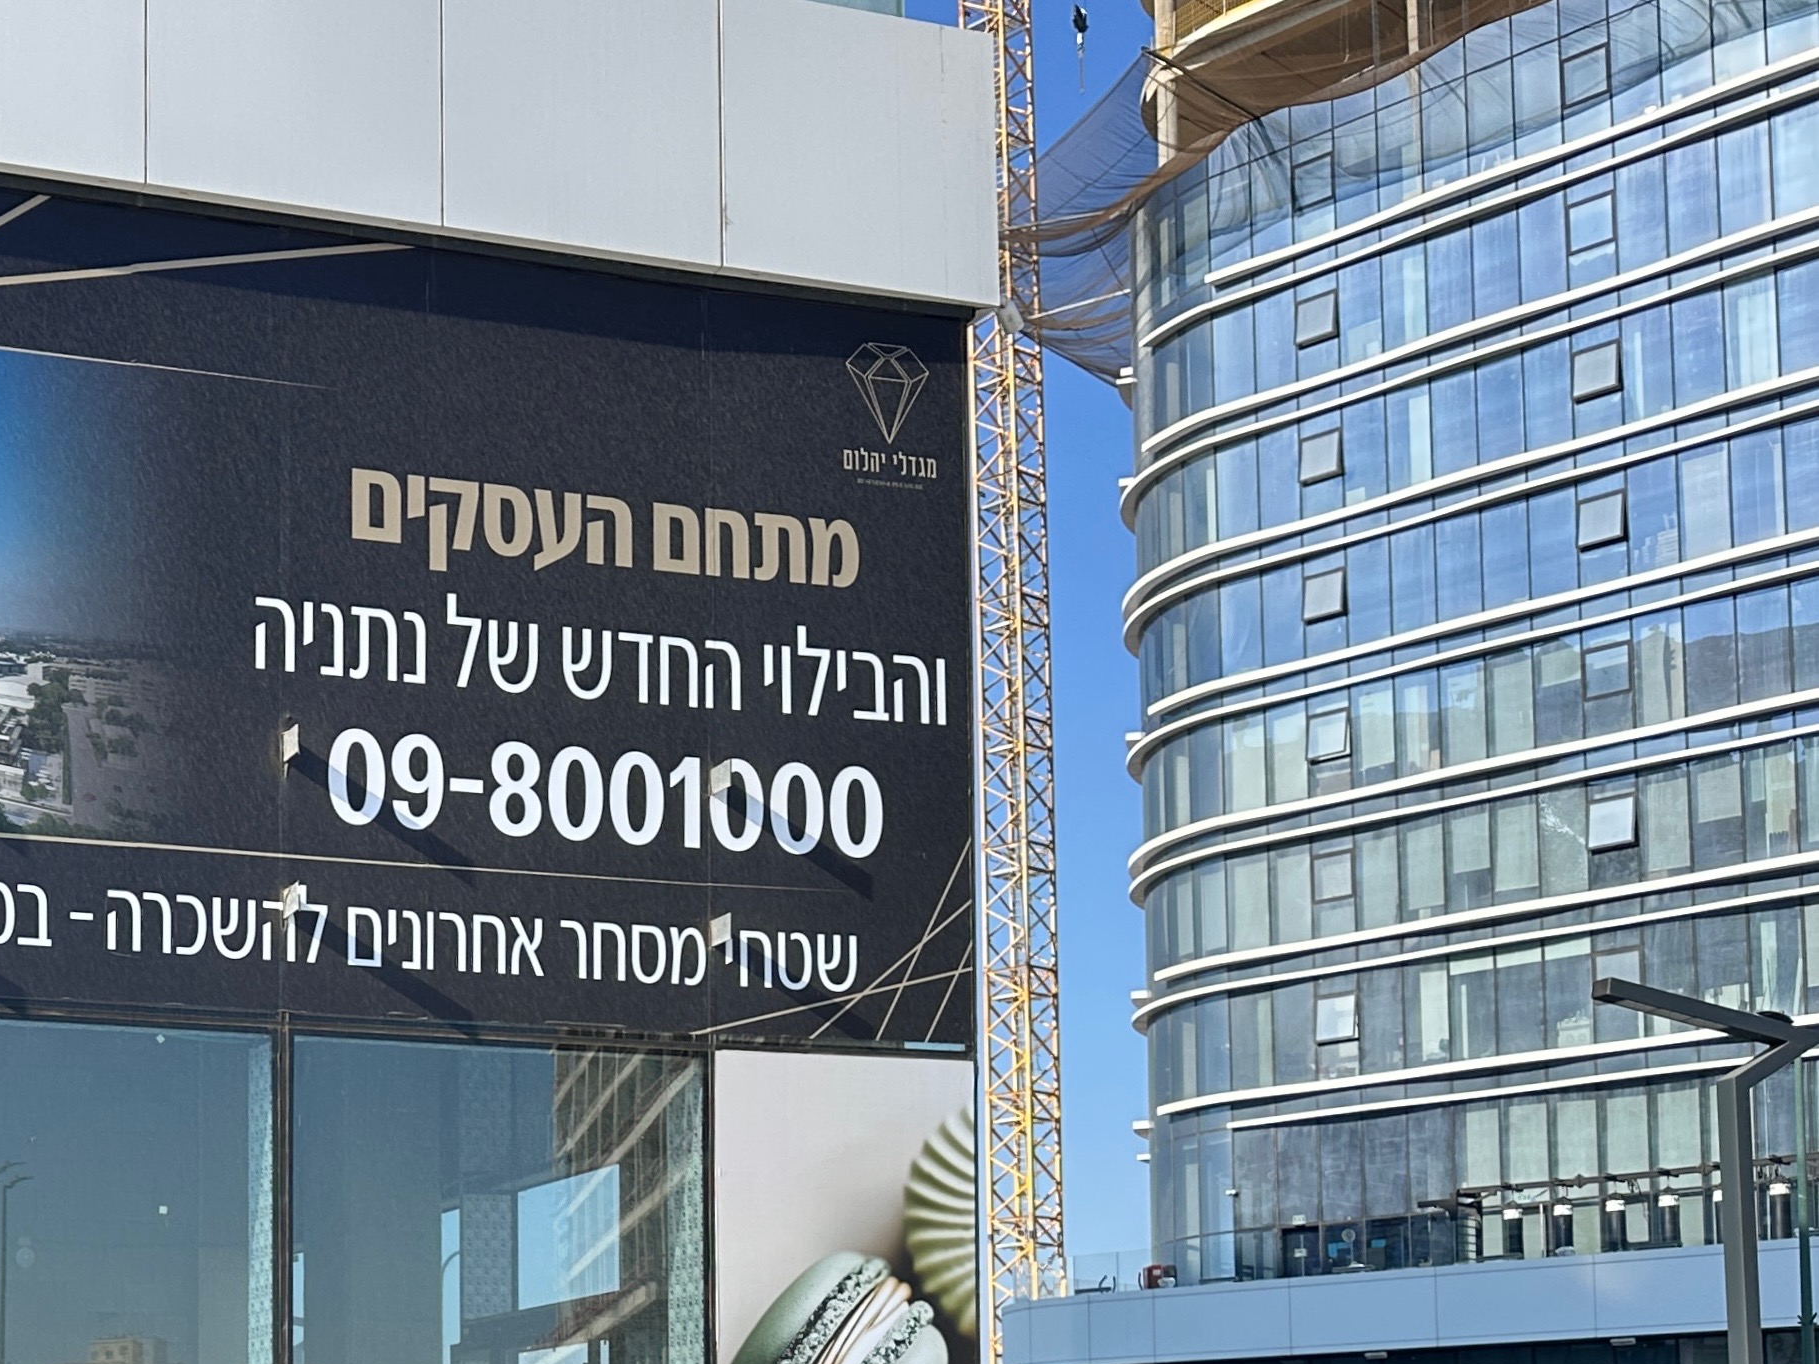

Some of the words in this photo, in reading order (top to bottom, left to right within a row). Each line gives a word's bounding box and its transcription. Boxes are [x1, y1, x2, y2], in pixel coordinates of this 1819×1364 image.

[842, 447, 886, 473] יהלום
[893, 451, 937, 479] מגדלי
[351, 467, 633, 572] העסקים
[652, 501, 860, 588] מתחם
[255, 596, 427, 685] נתניה
[446, 592, 539, 694] של
[562, 626, 742, 712] החדש
[764, 625, 947, 727] והבילוי
[327, 728, 884, 859] 09-8001000
[107, 884, 329, 964] להשכרה
[347, 906, 545, 977] אחרונים
[559, 919, 708, 986] מסחר
[724, 927, 858, 993] שטחי
